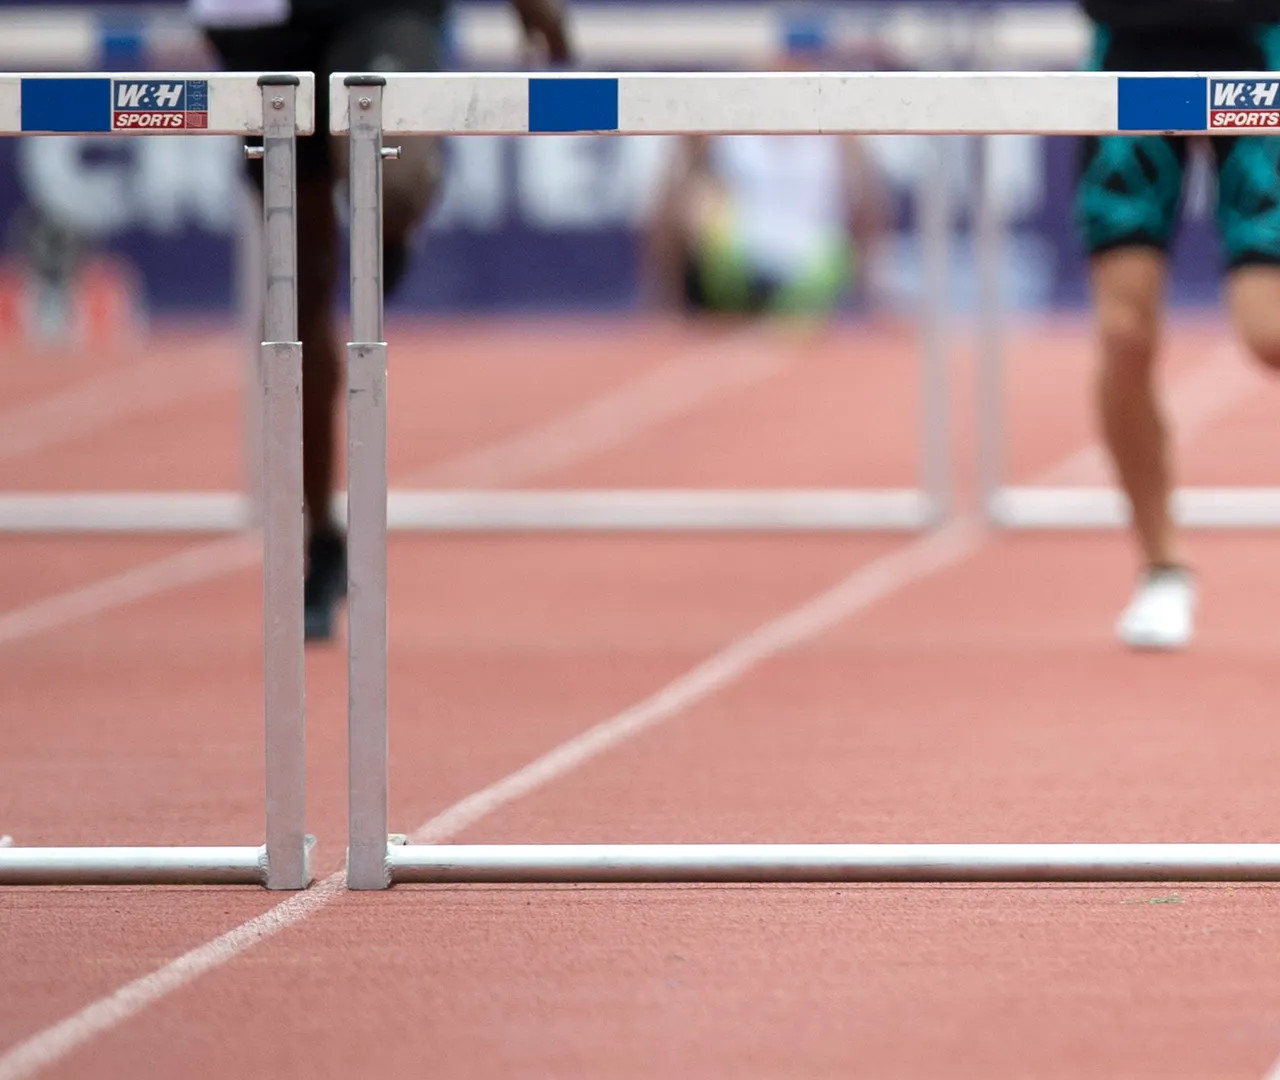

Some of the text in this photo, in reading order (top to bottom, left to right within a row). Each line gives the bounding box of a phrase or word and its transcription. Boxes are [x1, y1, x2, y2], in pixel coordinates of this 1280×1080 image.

[117, 84, 183, 107] W&H
[1214, 83, 1279, 106] W&H
[116, 114, 183, 127] SPORTS
[1213, 112, 1279, 126] SPORTS
